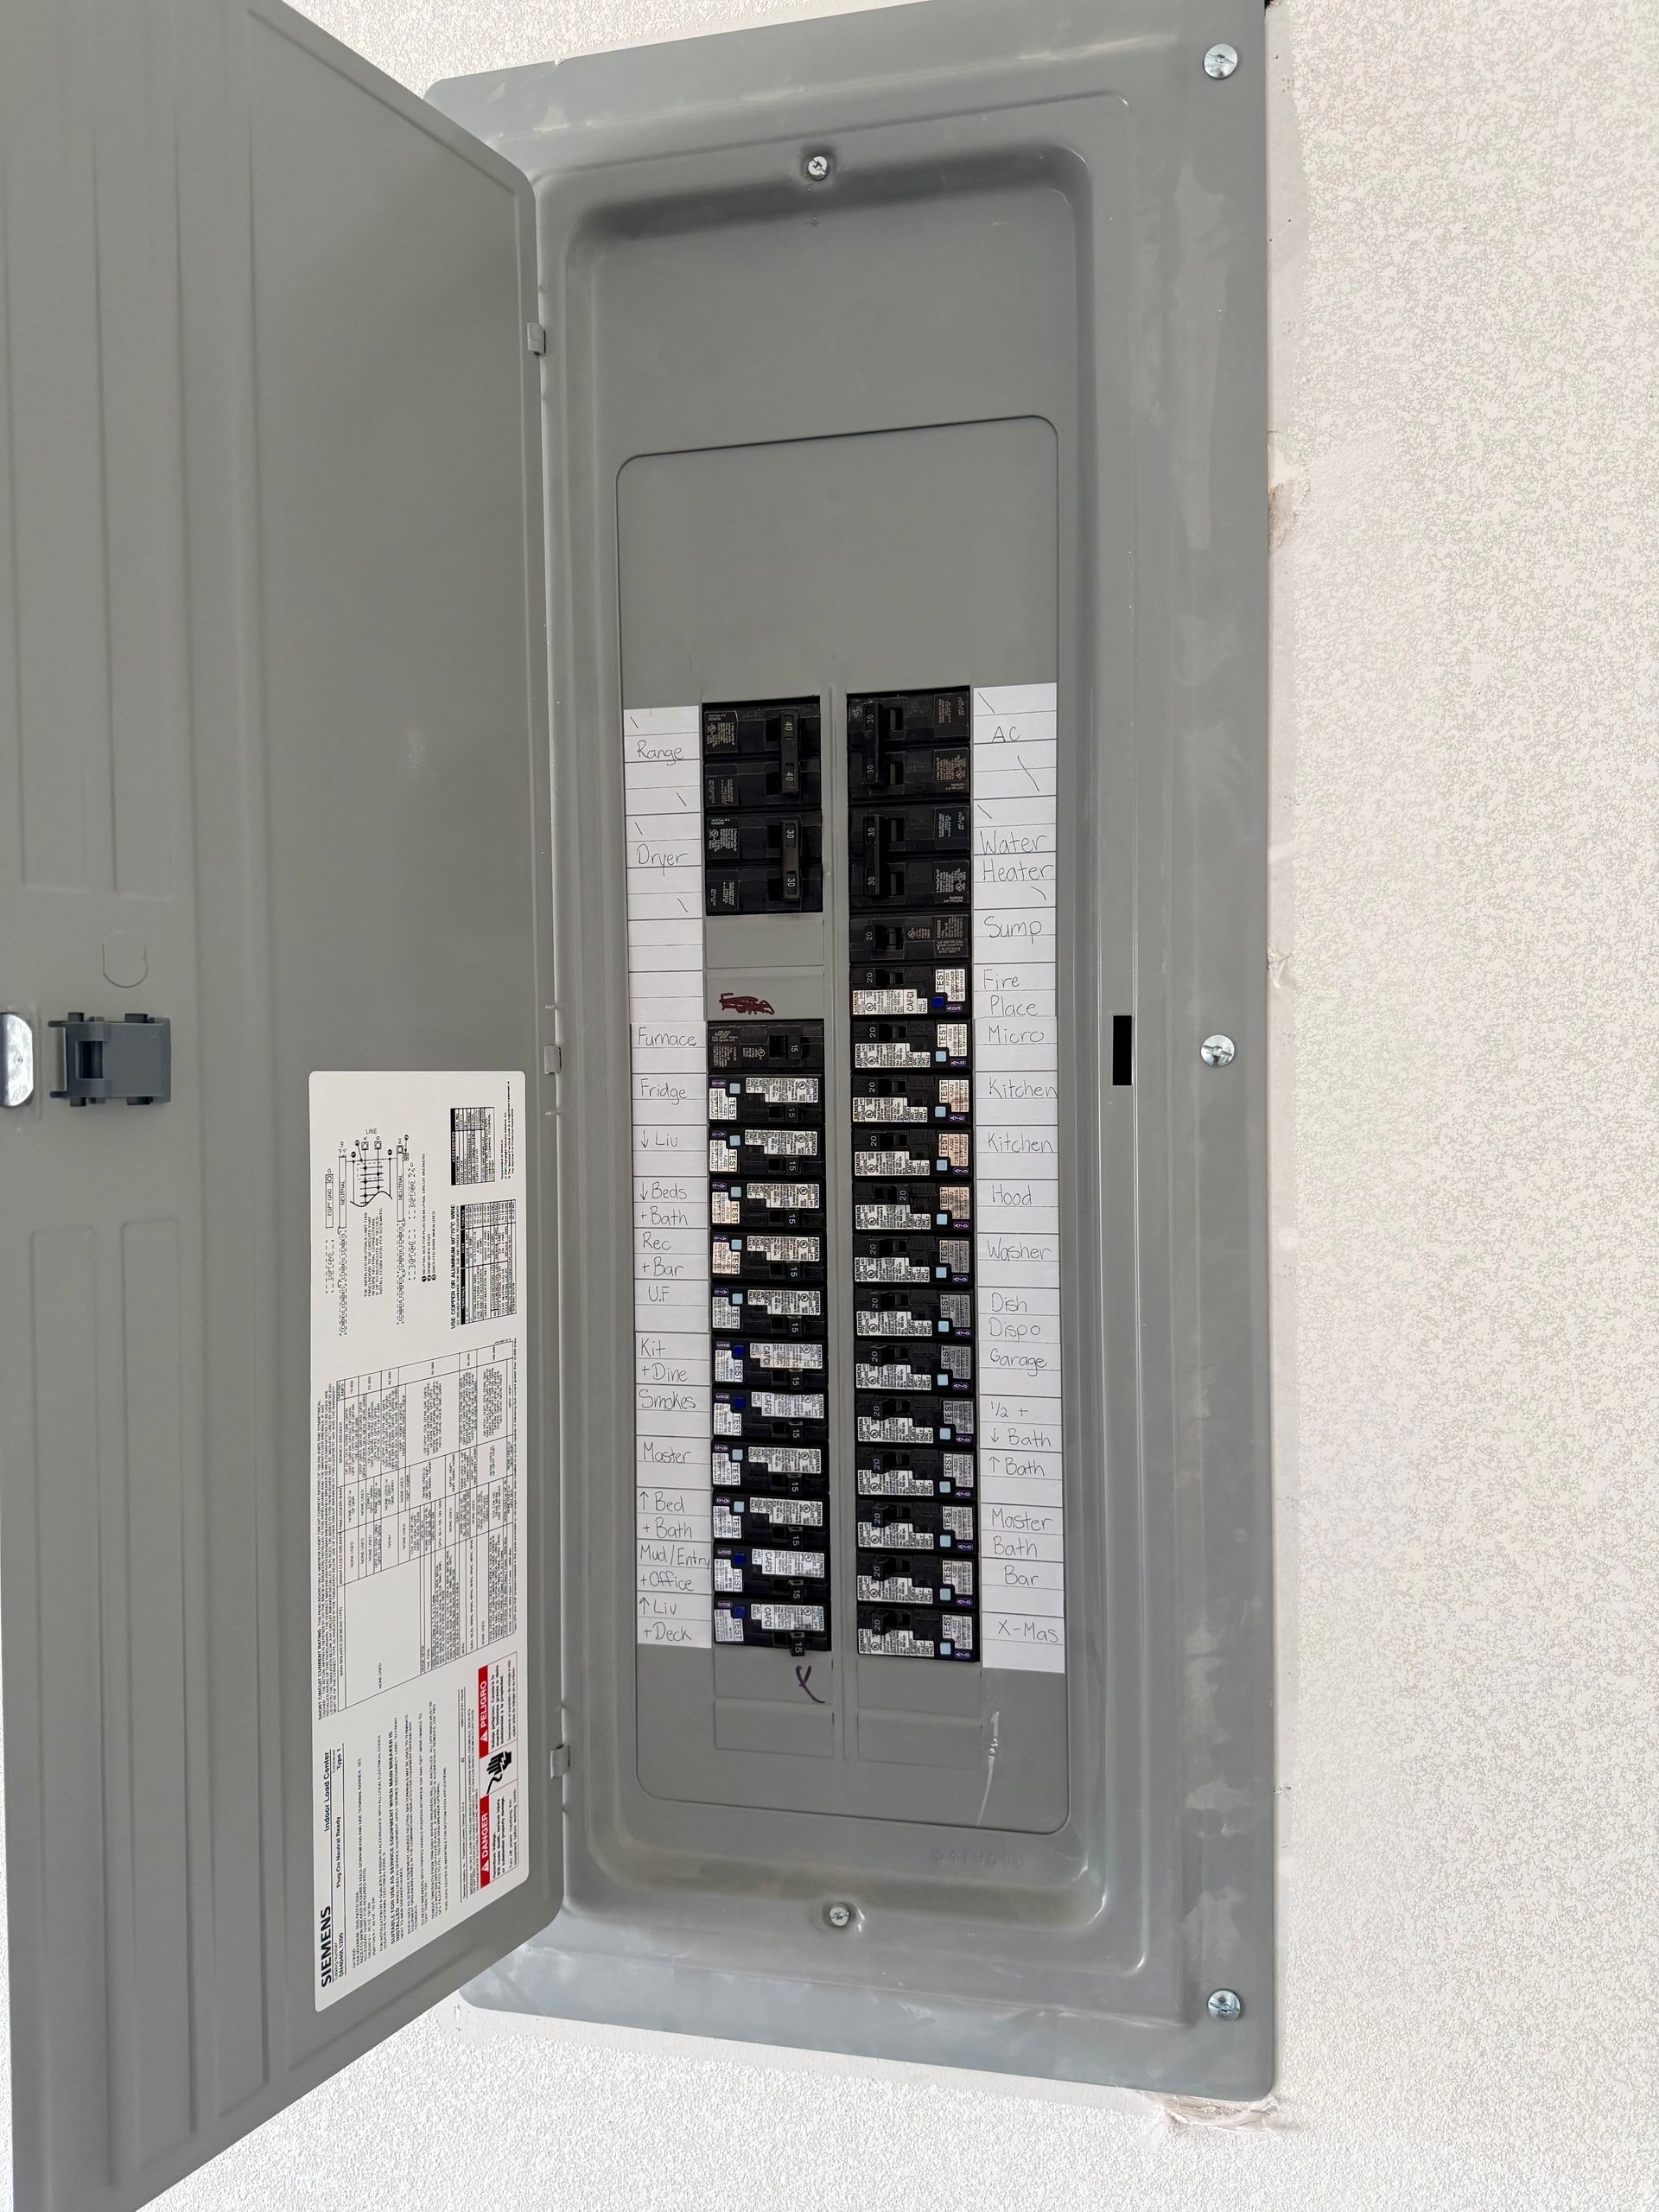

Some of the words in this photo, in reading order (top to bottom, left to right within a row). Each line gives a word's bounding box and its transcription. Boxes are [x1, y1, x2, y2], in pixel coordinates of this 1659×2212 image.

[785, 721, 792, 731] 40
[866, 714, 874, 723] 30
[637, 740, 685, 766] Range
[785, 772, 793, 781] 40
[866, 764, 874, 773] 30
[786, 830, 794, 839] 30
[867, 827, 875, 836] 30
[980, 830, 1047, 854] Water
[637, 843, 688, 876] Dryer
[982, 858, 1053, 882] Heater
[787, 878, 795, 887] 30
[867, 875, 875, 886] 30
[865, 931, 874, 941] 20
[984, 916, 1041, 944] Sump
[866, 972, 873, 983] 20
[983, 969, 1020, 989] Fire
[990, 995, 1039, 1017] Place
[638, 1027, 697, 1046] Furnace
[869, 1027, 876, 1038] 20
[988, 1025, 1044, 1043] Micro
[640, 1078, 688, 1105] Fridge
[868, 1082, 875, 1093] 20
[989, 1077, 1058, 1098] Kitchen
[789, 1108, 795, 1117] 15
[870, 1135, 877, 1147] 20
[988, 1132, 1053, 1153] Kitchen
[789, 1160, 796, 1171] 15
[652, 1182, 688, 1199] Beds
[899, 1190, 906, 1201] 20
[992, 1184, 1032, 1205] Hood
[651, 1206, 688, 1226] Bath
[789, 1213, 796, 1224] 15
[643, 1232, 671, 1250] Rec
[869, 1244, 876, 1255] 20
[988, 1238, 1051, 1261] Washer
[652, 1256, 684, 1276] Bar
[791, 1267, 798, 1277] 15
[871, 1297, 878, 1308] 20
[991, 1293, 1027, 1313] Dish
[791, 1322, 798, 1332] 15
[989, 1317, 1041, 1342] Dispo
[641, 1335, 665, 1357] Kit
[871, 1351, 878, 1362] 20
[990, 1348, 1047, 1376] Garage
[652, 1363, 688, 1382] Dine
[793, 1376, 799, 1386] 15
[639, 1389, 696, 1411] Smokes
[873, 1406, 880, 1417] 20
[792, 1428, 799, 1439] 15
[1009, 1428, 1052, 1446] Bath
[643, 1442, 690, 1463] Master
[873, 1459, 880, 1470] 20
[1006, 1458, 1046, 1476] Bath
[791, 1482, 798, 1492] 15
[655, 1492, 684, 1512] Bed
[656, 1516, 692, 1539] Bath
[874, 1513, 880, 1524] 20
[991, 1509, 1052, 1530] Master
[792, 1535, 799, 1546] 15
[994, 1535, 1037, 1557] Bath
[874, 1566, 880, 1577] 20
[1004, 1565, 1039, 1586] Bar
[792, 1590, 800, 1599] 15
[653, 1598, 677, 1613] Liv
[734, 1618, 742, 1641] TEST
[874, 1619, 880, 1630] 20
[998, 1619, 1058, 1643] X-Mas
[795, 1643, 803, 1653] 15
[480, 1681, 488, 1729] PELIGRO
[480, 1813, 489, 1858] DANGER
[321, 1905, 332, 1988] SIEMENS
